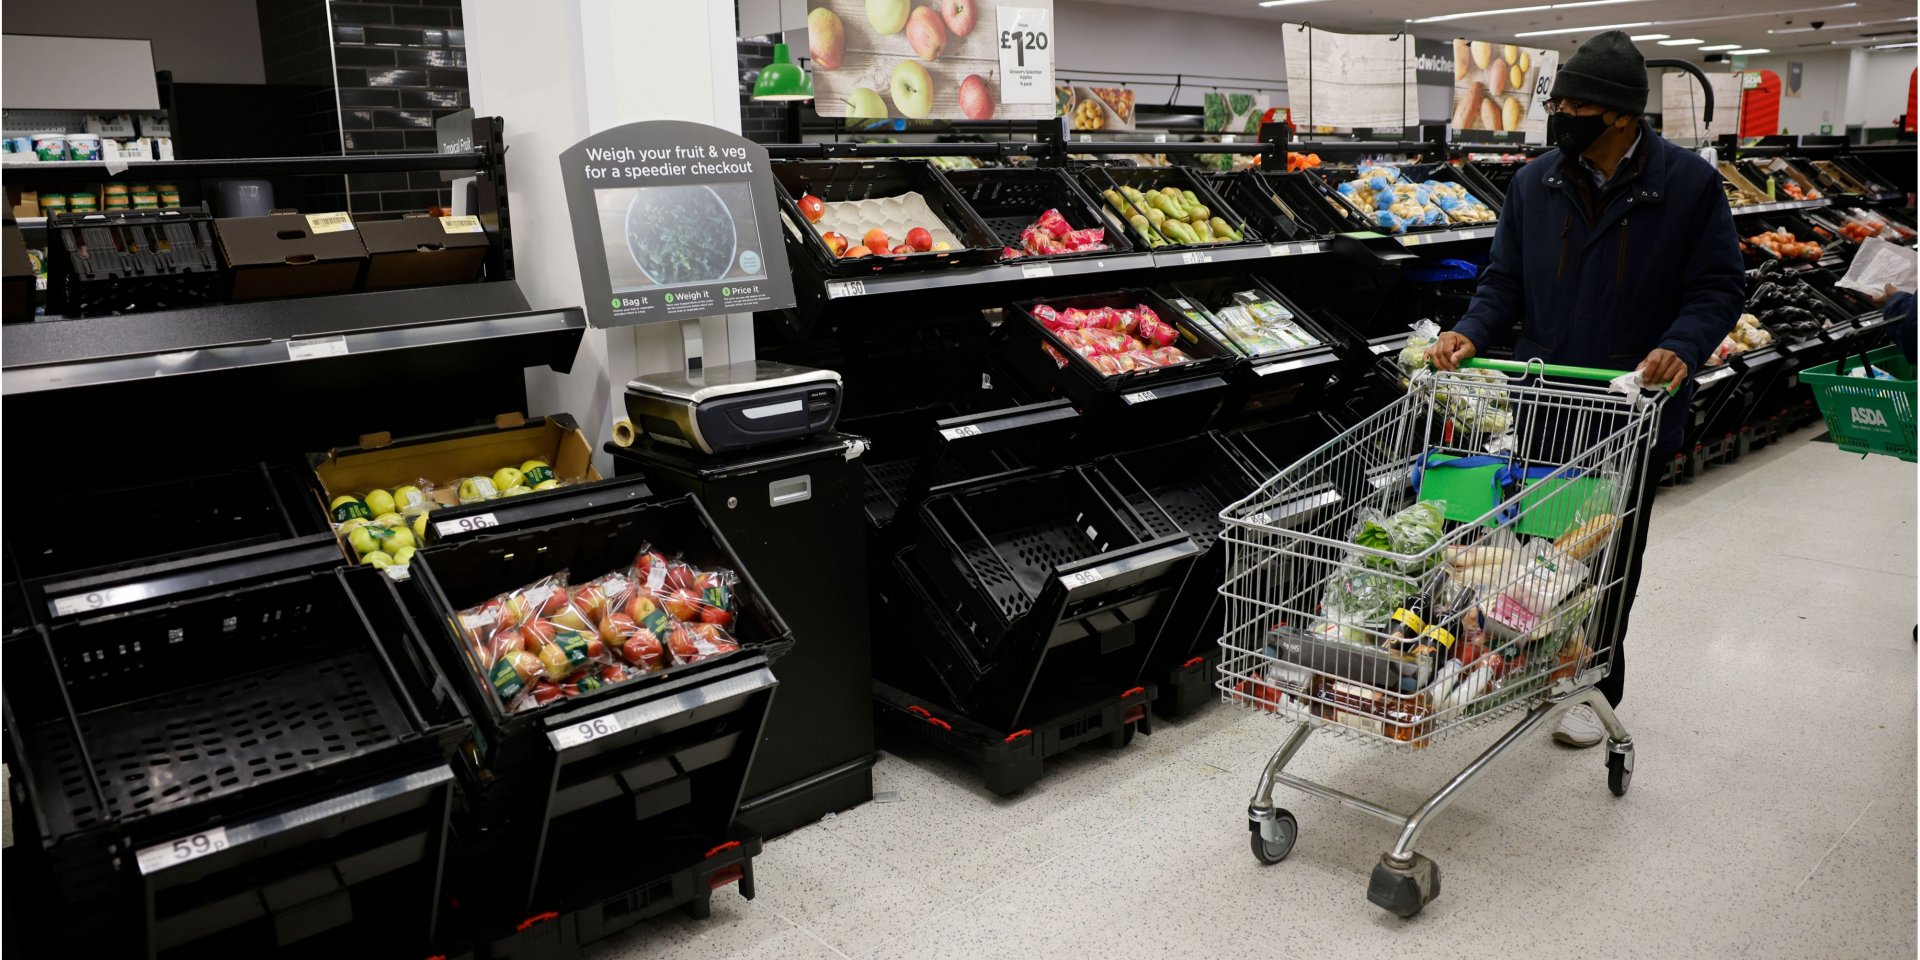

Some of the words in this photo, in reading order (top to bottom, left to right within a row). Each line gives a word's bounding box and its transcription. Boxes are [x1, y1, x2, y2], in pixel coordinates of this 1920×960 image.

[586, 147, 635, 163] Weigh
[639, 148, 671, 162] your
[675, 145, 705, 159] fruit
[708, 146, 718, 158] &
[721, 146, 746, 160] veg
[585, 165, 606, 179] for
[611, 168, 621, 178] a
[625, 162, 687, 179] speedier
[690, 161, 753, 175] checkout
[675, 291, 701, 301] Weigh
[703, 290, 709, 298] it
[732, 286, 751, 295] Price
[753, 285, 759, 293] it
[622, 298, 640, 307] Bag
[641, 296, 648, 304] it
[1850, 406, 1888, 427] ASDA
[173, 834, 224, 859] 59p
